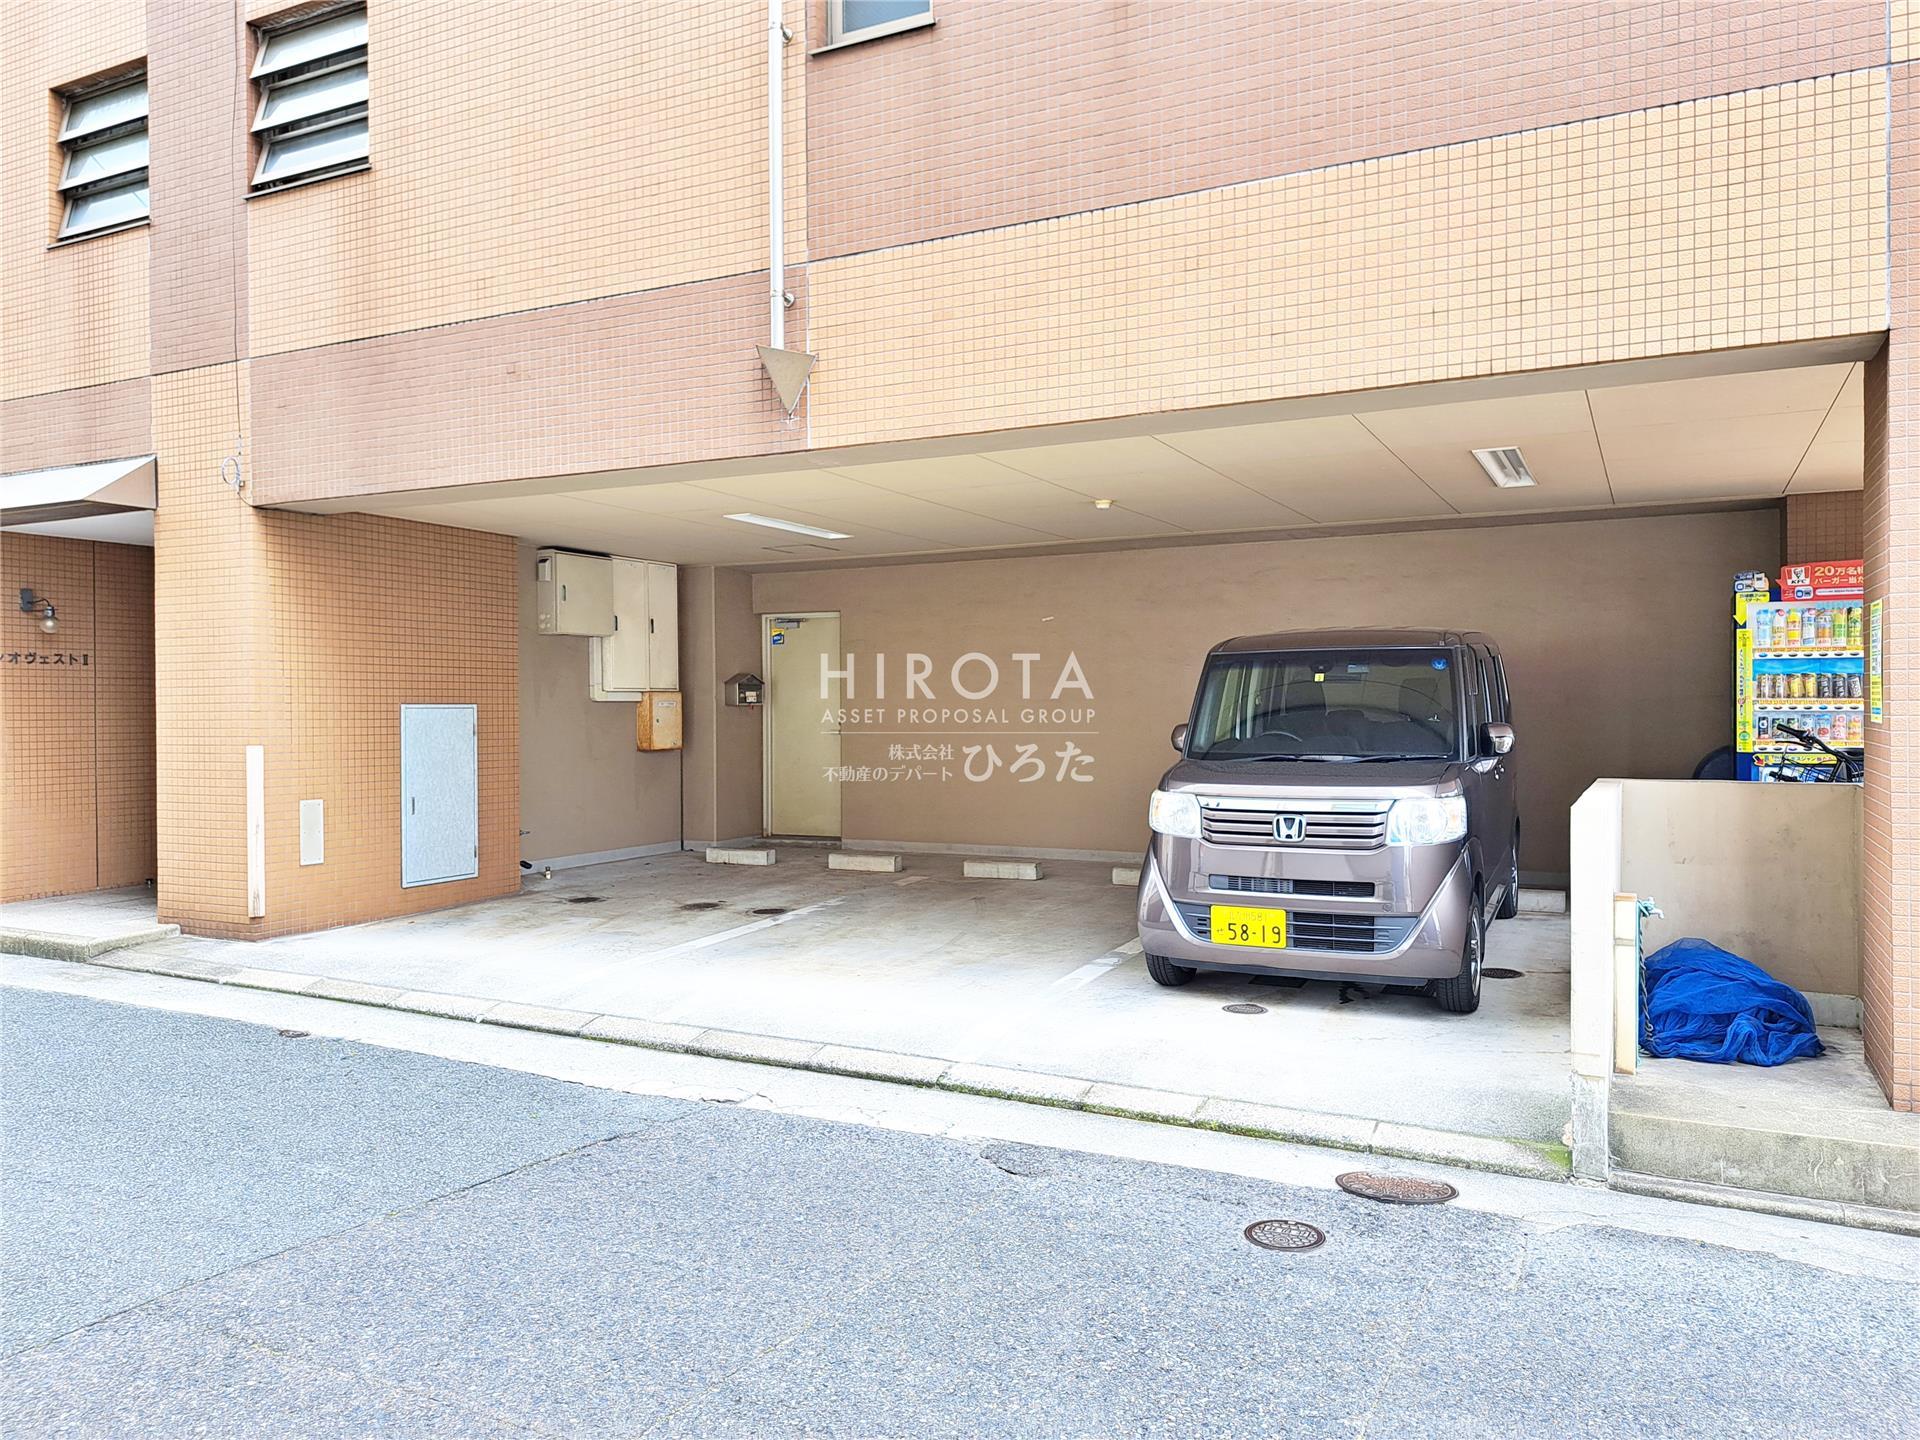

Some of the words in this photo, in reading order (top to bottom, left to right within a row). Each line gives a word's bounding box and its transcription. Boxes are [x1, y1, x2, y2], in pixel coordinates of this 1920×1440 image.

[0, 652, 89, 666] オヴェストⅡ
[1228, 923, 1281, 944] 58-19
